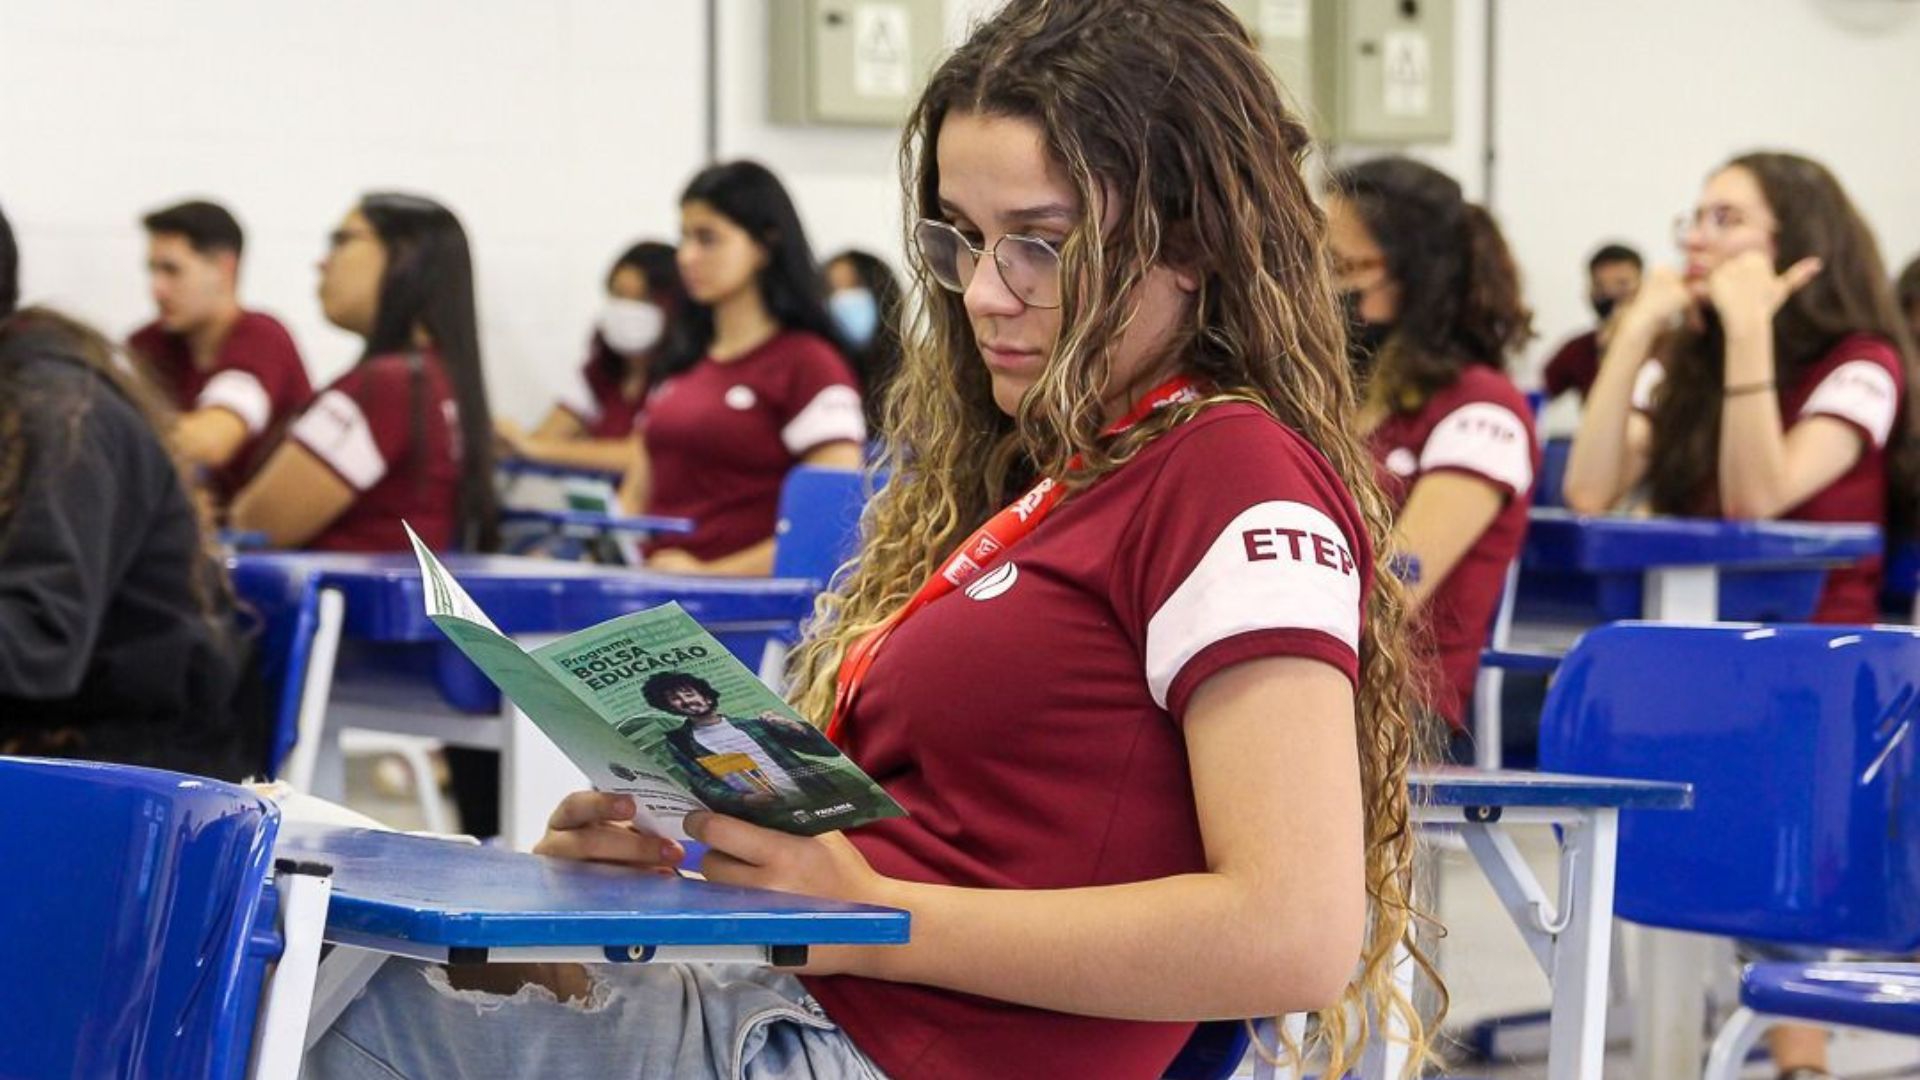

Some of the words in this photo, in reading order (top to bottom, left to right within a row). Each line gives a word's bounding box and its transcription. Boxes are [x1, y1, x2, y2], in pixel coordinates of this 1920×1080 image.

[1242, 527, 1353, 576] ETEP
[560, 637, 635, 668] Programa
[571, 646, 650, 680] BOLSA
[585, 646, 709, 691] EDUCAÇÃO
